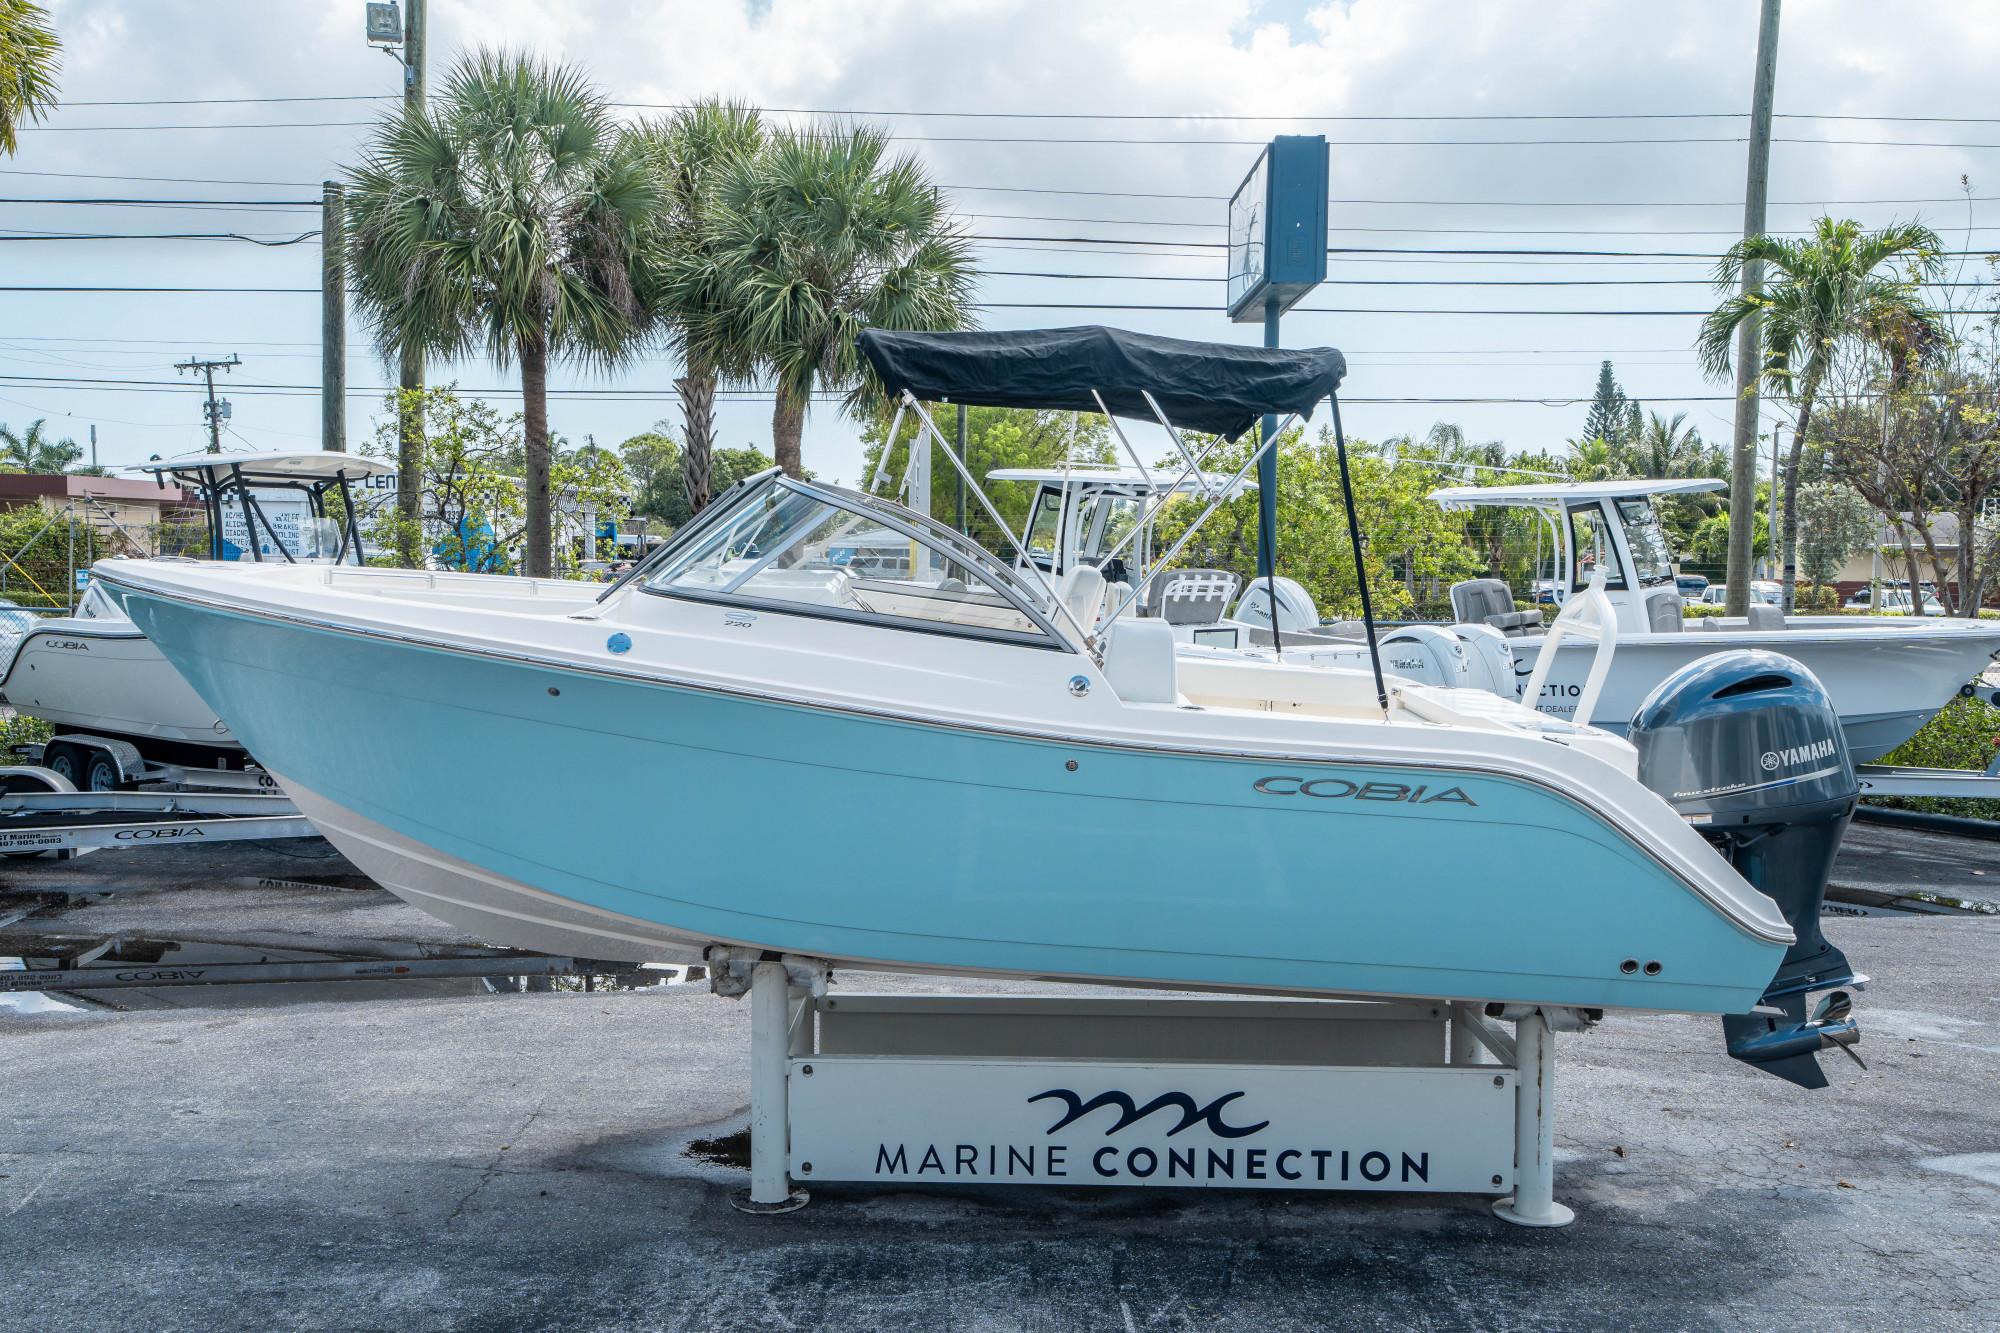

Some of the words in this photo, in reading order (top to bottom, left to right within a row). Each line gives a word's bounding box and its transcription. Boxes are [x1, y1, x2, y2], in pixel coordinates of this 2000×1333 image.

[724, 620, 752, 628] 220
[45, 640, 89, 650] COBIA
[1779, 738, 1836, 767] YAMAHA
[1252, 775, 1480, 807] COBIA
[114, 827, 205, 840] COBIA
[875, 1143, 1068, 1177] MARINE
[1092, 1145, 1429, 1184] CONNECTION
